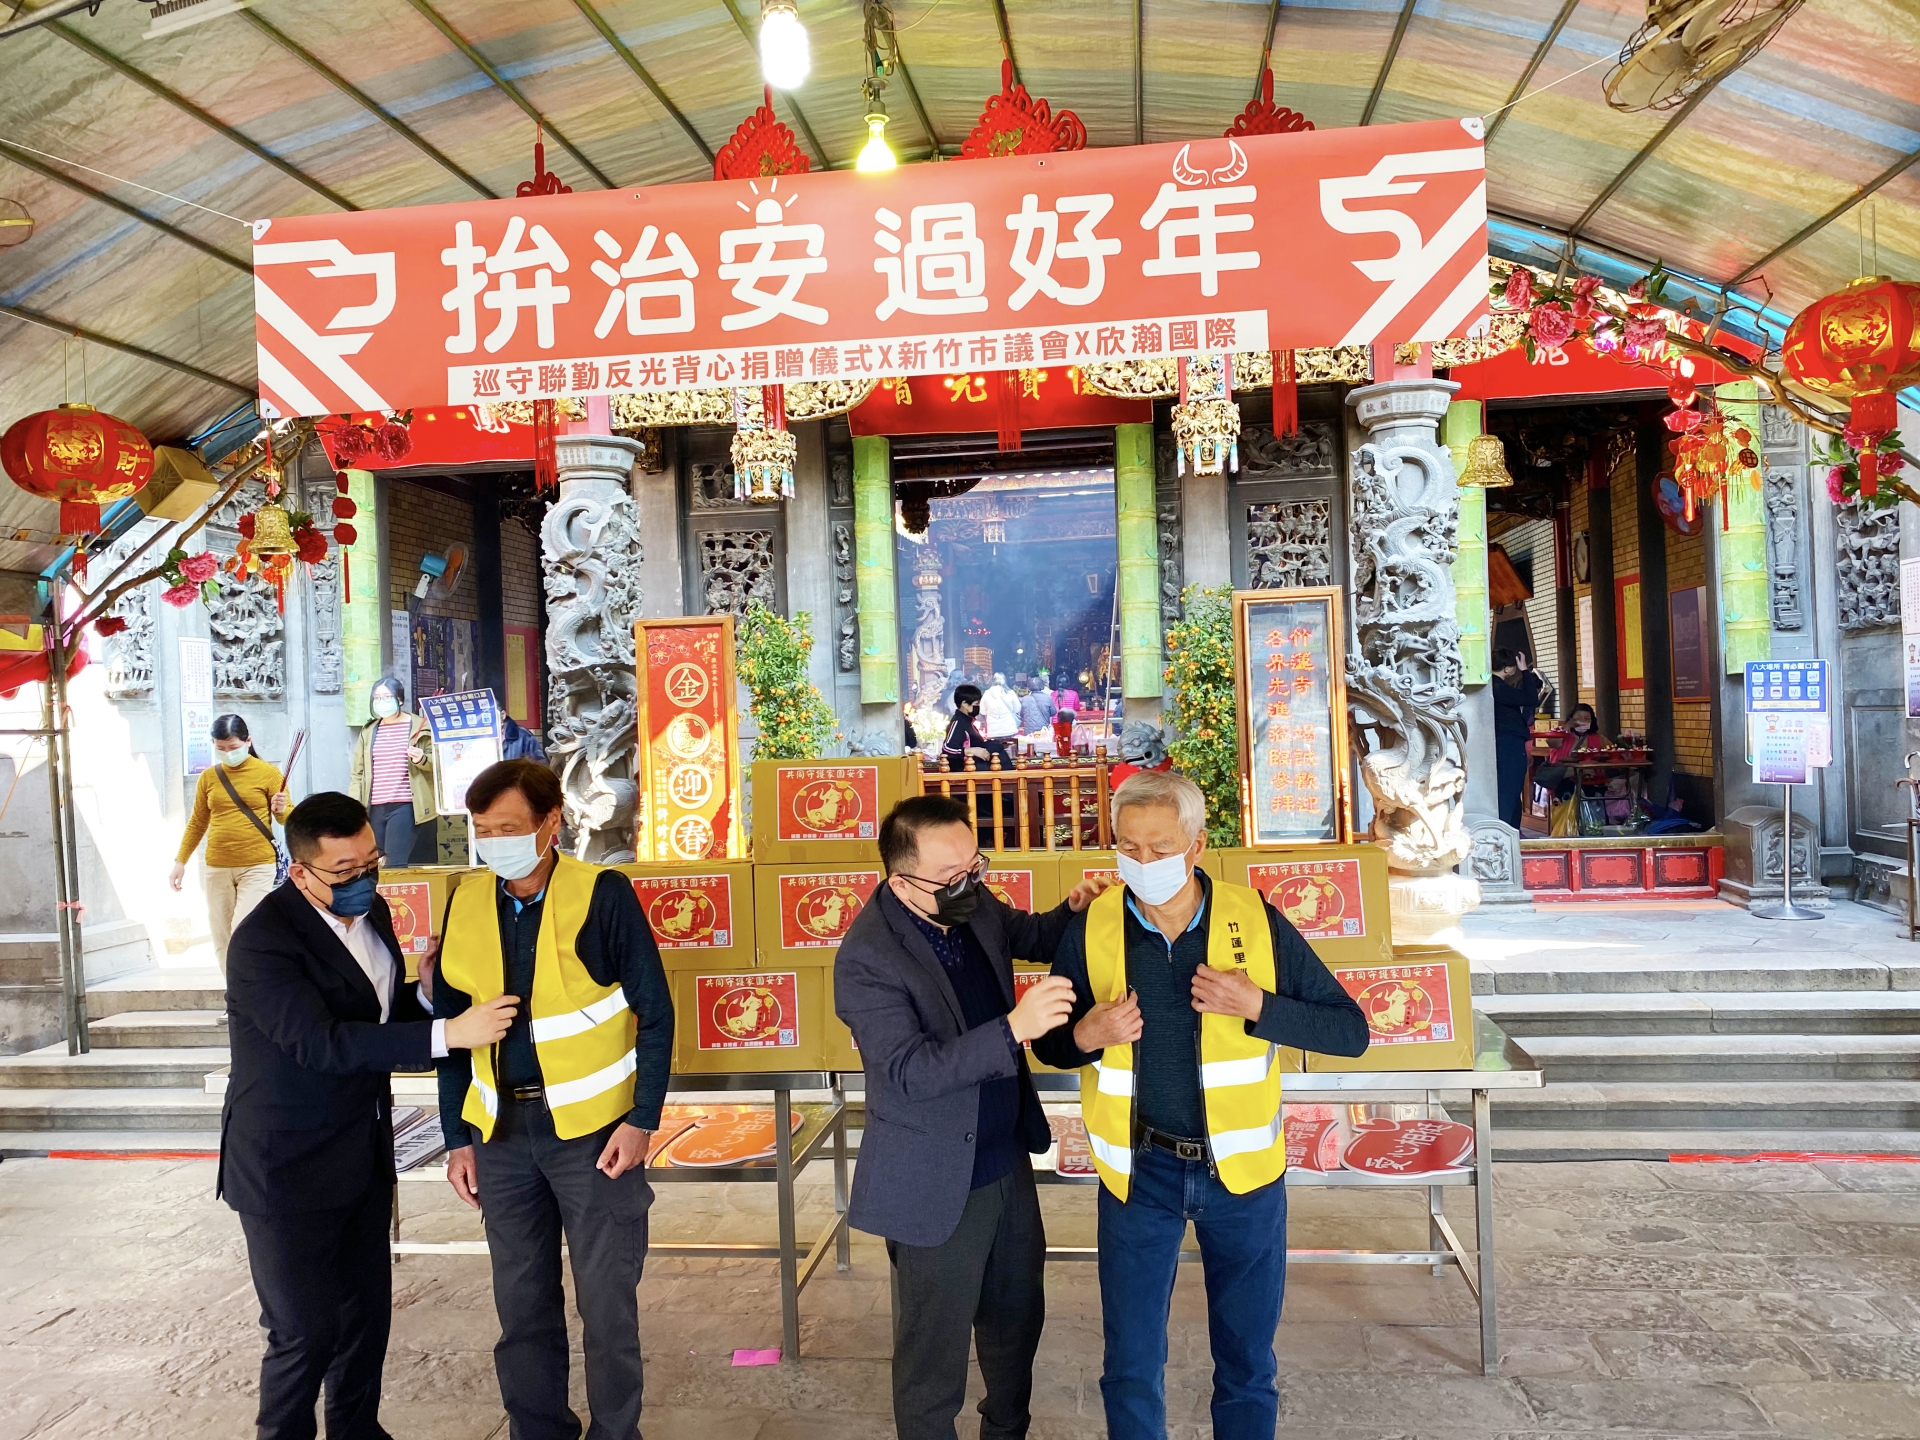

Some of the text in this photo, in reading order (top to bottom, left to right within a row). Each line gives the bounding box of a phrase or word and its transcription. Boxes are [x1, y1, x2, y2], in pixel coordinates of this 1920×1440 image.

[873, 182, 1261, 321] 過好年
[670, 667, 703, 701] 金
[1257, 863, 1346, 876] 共同守護家園安全
[1345, 966, 1435, 981] 共同守護家園安全
